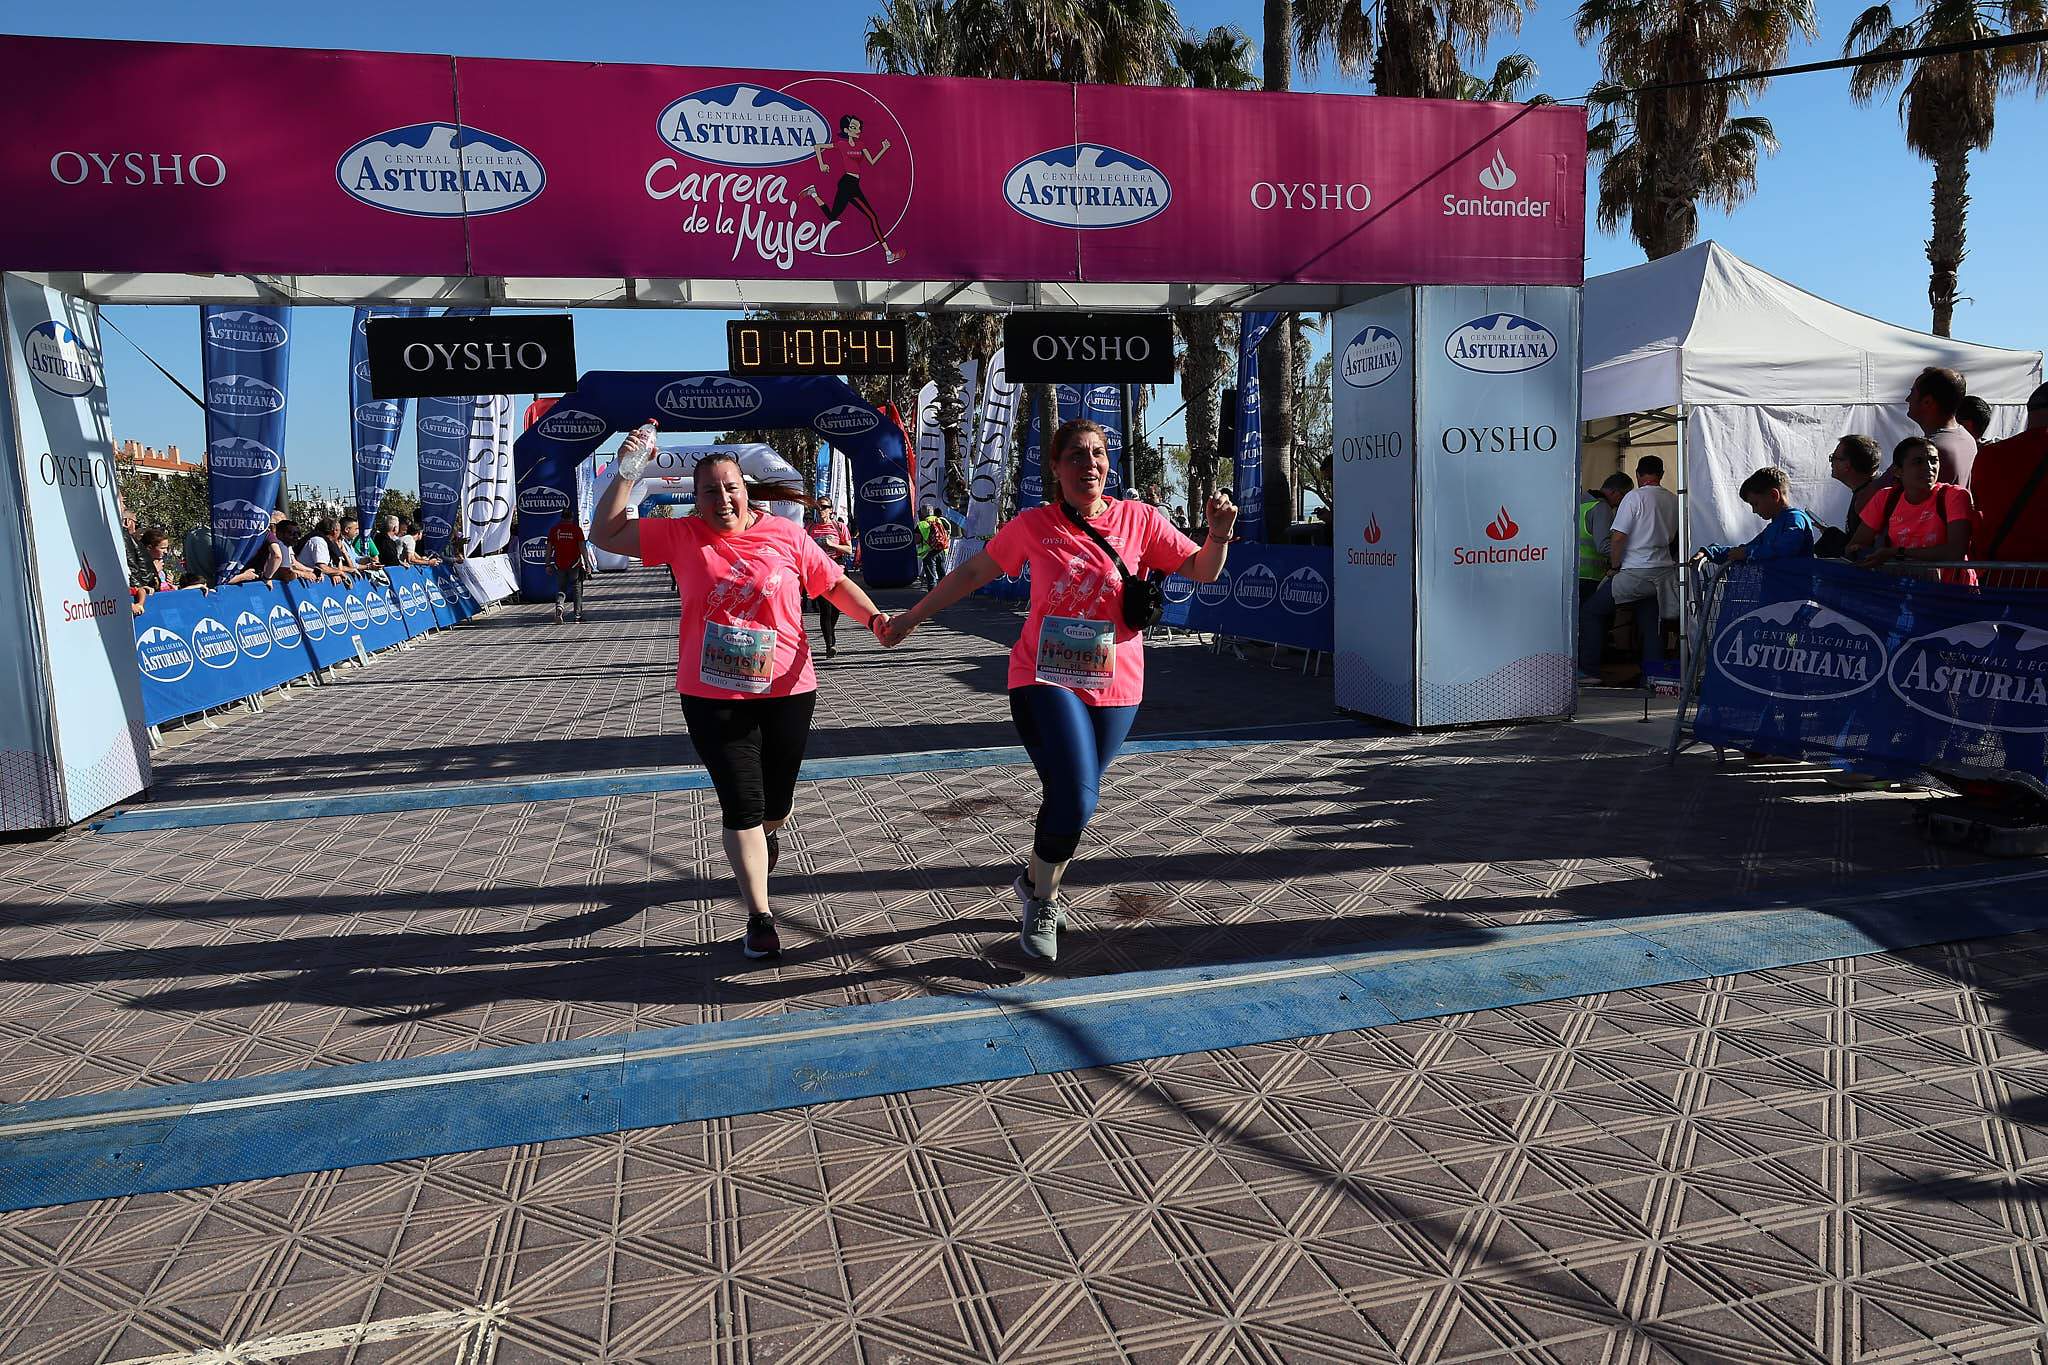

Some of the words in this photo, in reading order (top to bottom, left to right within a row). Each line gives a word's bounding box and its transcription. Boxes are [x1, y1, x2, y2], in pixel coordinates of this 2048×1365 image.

[698, 111, 752, 121] CENTRAL
[758, 112, 812, 123] LECHERA
[672, 112, 817, 147] ASTURIANA
[50, 151, 227, 187] OYSHO
[384, 154, 450, 165] CENTRAL
[354, 156, 531, 193] ASTURIANA
[645, 158, 788, 204] Carrera
[1042, 172, 1095, 182] CENTRAL
[1100, 173, 1153, 183] LECHERA
[1017, 173, 1159, 207] ASTURIANA
[1250, 182, 1372, 212] OYSHO
[1443, 193, 1551, 218] Santander
[683, 204, 709, 234] de
[716, 204, 735, 234] la
[732, 200, 842, 270] Mujer
[403, 341, 548, 372] OYSHO
[1032, 335, 1150, 362] OYSHO
[1453, 336, 1549, 360] ASTURIANA
[32, 341, 93, 383] ASTURIANA
[1345, 351, 1397, 377] ASTURIANA
[664, 390, 755, 409] ASTURIANA
[423, 418, 465, 436] ASTURIANA
[542, 422, 601, 434] ASTURIANA
[819, 415, 874, 429] ASTURIANA
[969, 367, 1018, 503] OYSHO
[1341, 431, 1402, 463] OYSHO
[1441, 424, 1558, 455] OYSHO
[40, 452, 108, 489] OYSHO
[419, 454, 460, 469] ASTURIANA
[656, 449, 740, 469] OYS
[423, 490, 455, 502] STURIANA
[520, 496, 567, 508] ASTURIANA
[863, 485, 907, 497] ASTURIANA
[868, 533, 911, 546] ASTURIANA
[1347, 547, 1398, 567] Santander
[1453, 543, 1549, 566] Santander
[63, 597, 118, 622] Santander
[197, 639, 237, 659] ASTURIANA
[1753, 629, 1806, 643] CENTRAL
[1811, 634, 1870, 651] LECHERA
[141, 648, 192, 672] ASTURIANA
[1722, 630, 1869, 682] ASTURIANA
